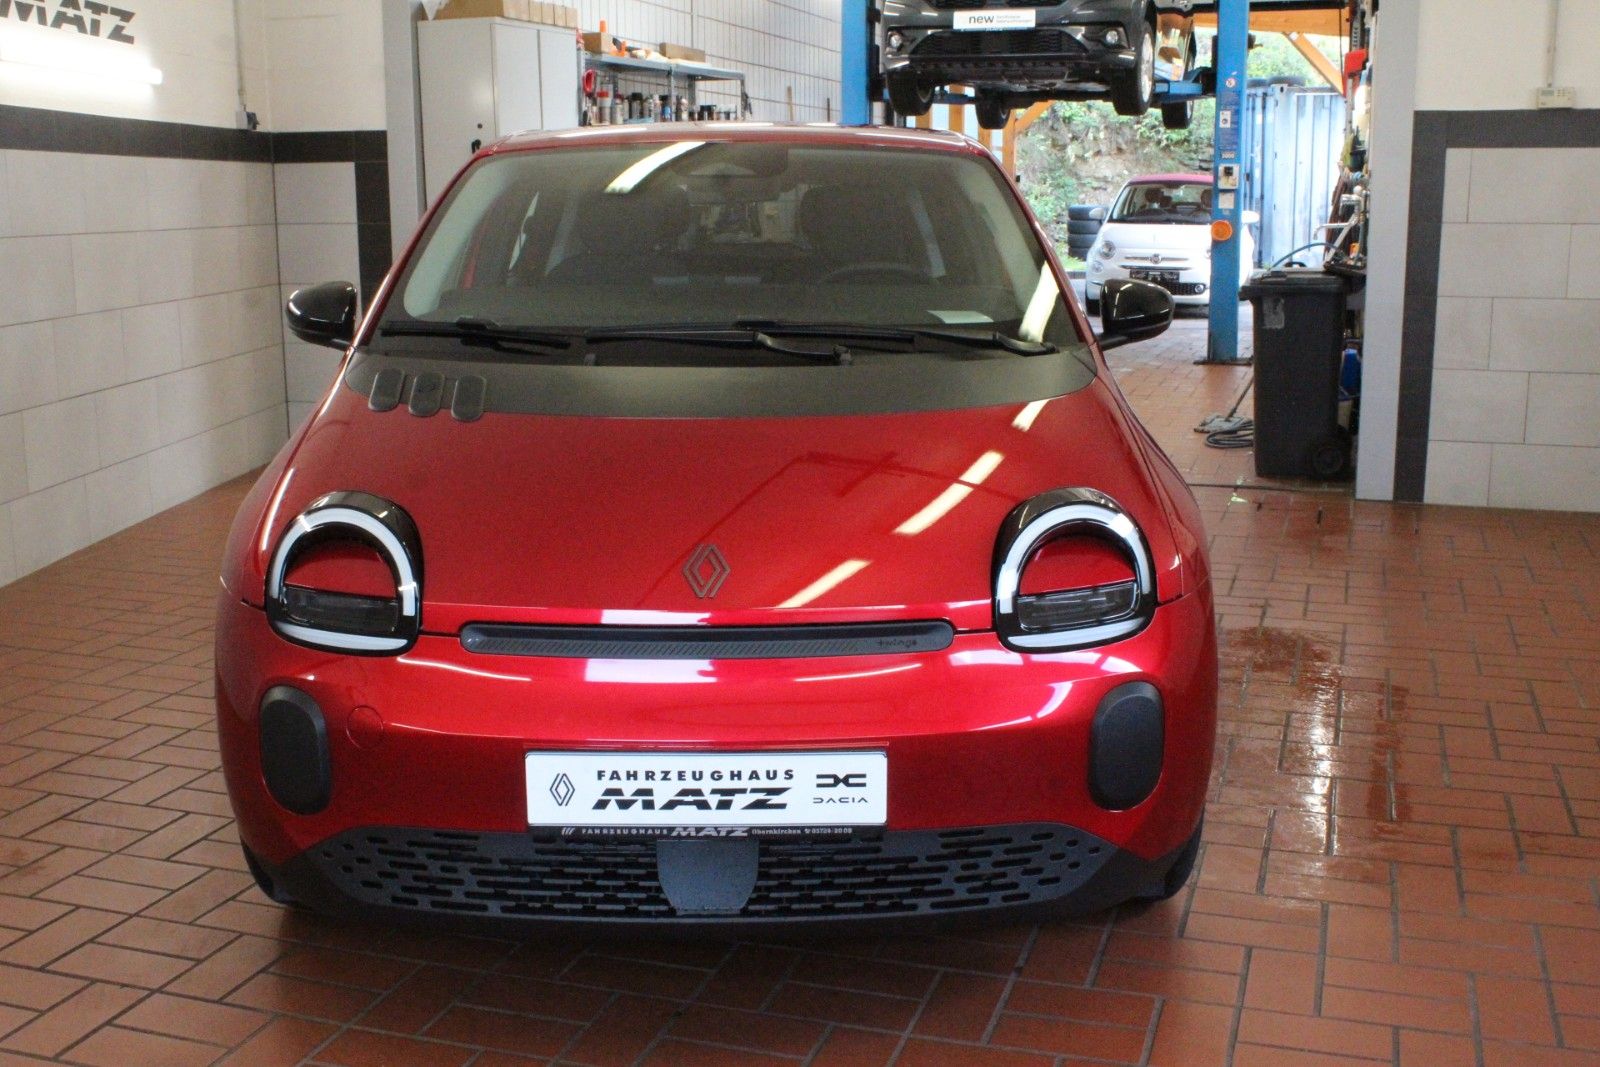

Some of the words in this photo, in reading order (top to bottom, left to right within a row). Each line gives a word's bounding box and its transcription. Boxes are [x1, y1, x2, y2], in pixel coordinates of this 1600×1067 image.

[968, 15, 994, 24] new
[597, 769, 794, 781] FAHRZEUGHAUS
[591, 787, 792, 811] MATZ
[582, 828, 669, 836] FAHRZEUGHAUS
[670, 827, 749, 837] MATZ
